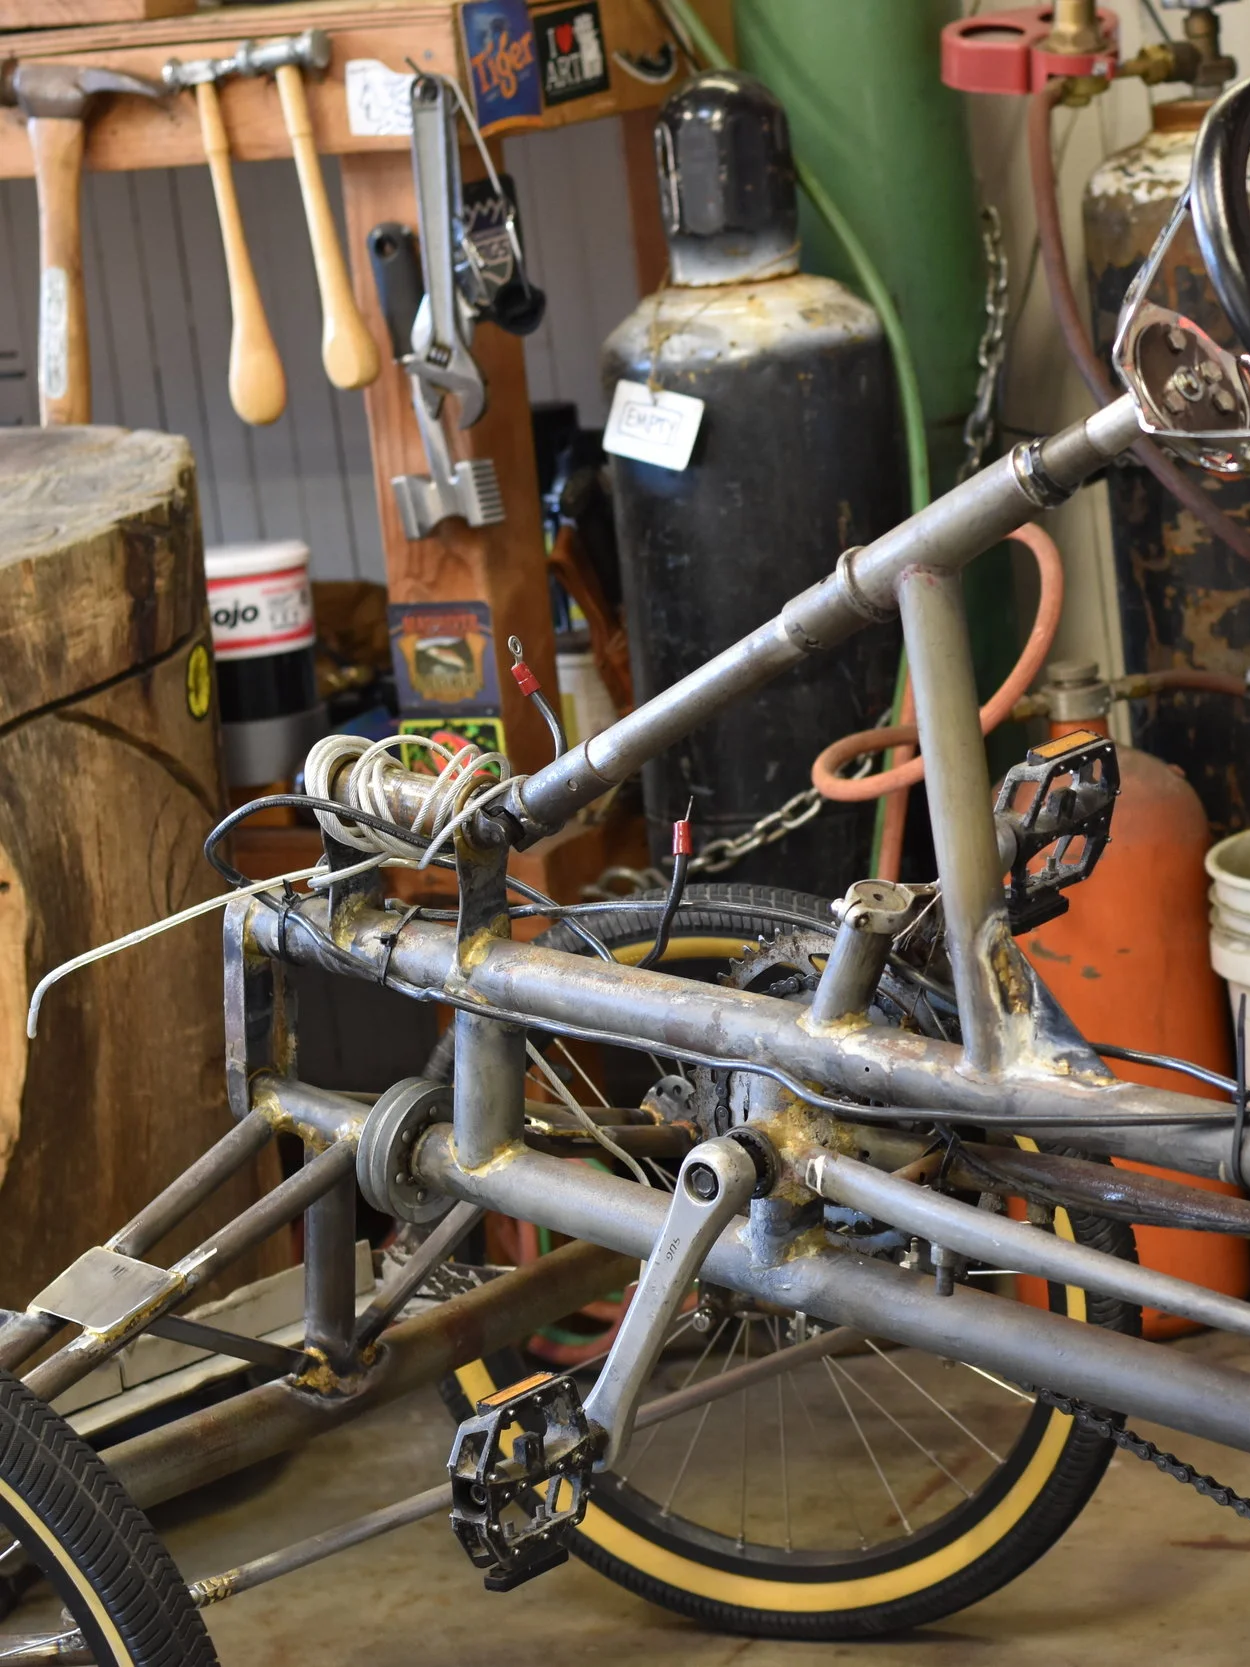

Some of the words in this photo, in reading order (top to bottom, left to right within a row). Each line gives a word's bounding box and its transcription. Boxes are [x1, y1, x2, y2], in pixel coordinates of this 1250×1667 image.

[470, 31, 535, 99] Tiger
[546, 53, 582, 92] ART
[625, 407, 678, 444] EMPTY
[212, 599, 259, 630] ojo
